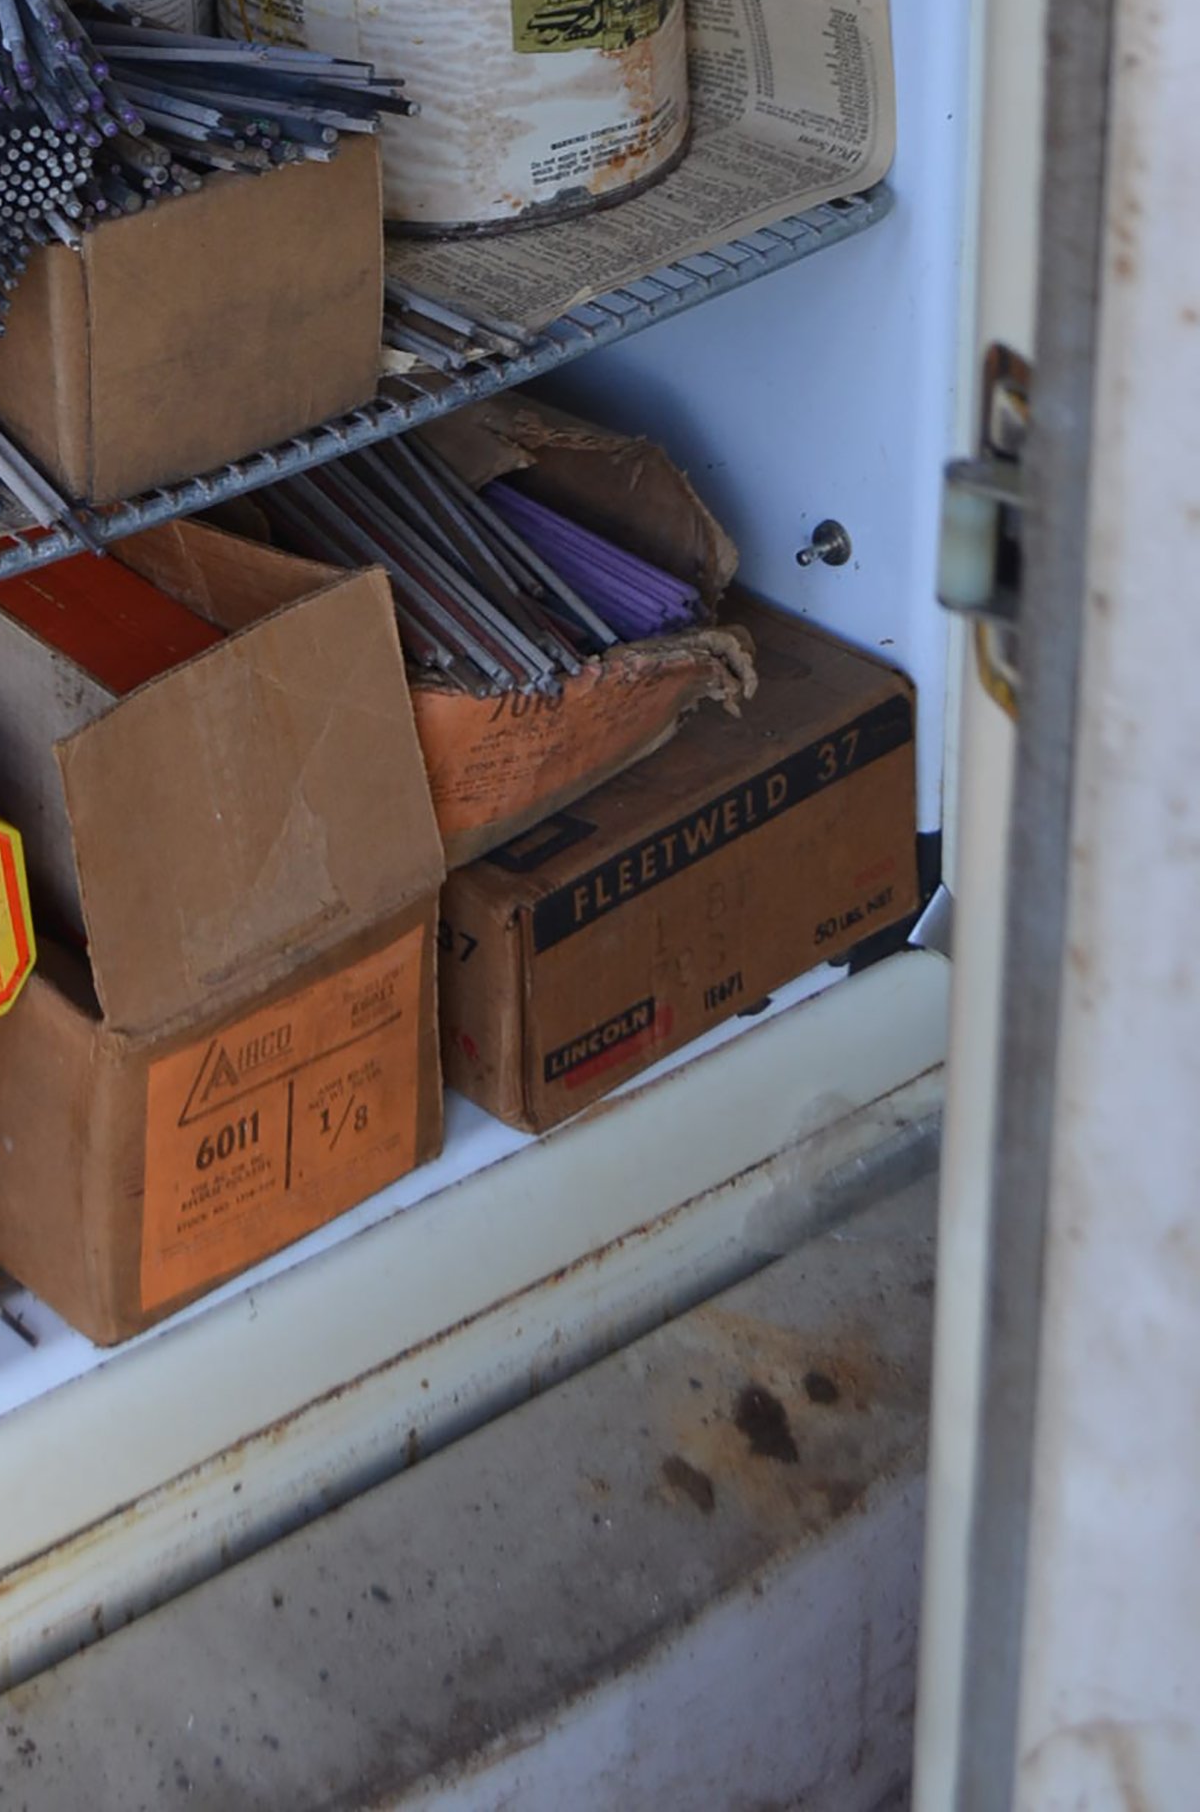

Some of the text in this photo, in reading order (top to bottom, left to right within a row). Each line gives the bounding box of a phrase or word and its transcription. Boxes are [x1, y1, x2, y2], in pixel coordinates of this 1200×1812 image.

[573, 729, 860, 922] FLEETWELD 37
[550, 1004, 649, 1073] LINCOLN
[195, 1109, 260, 1171] 6011
[319, 1094, 369, 1151] 1/8
